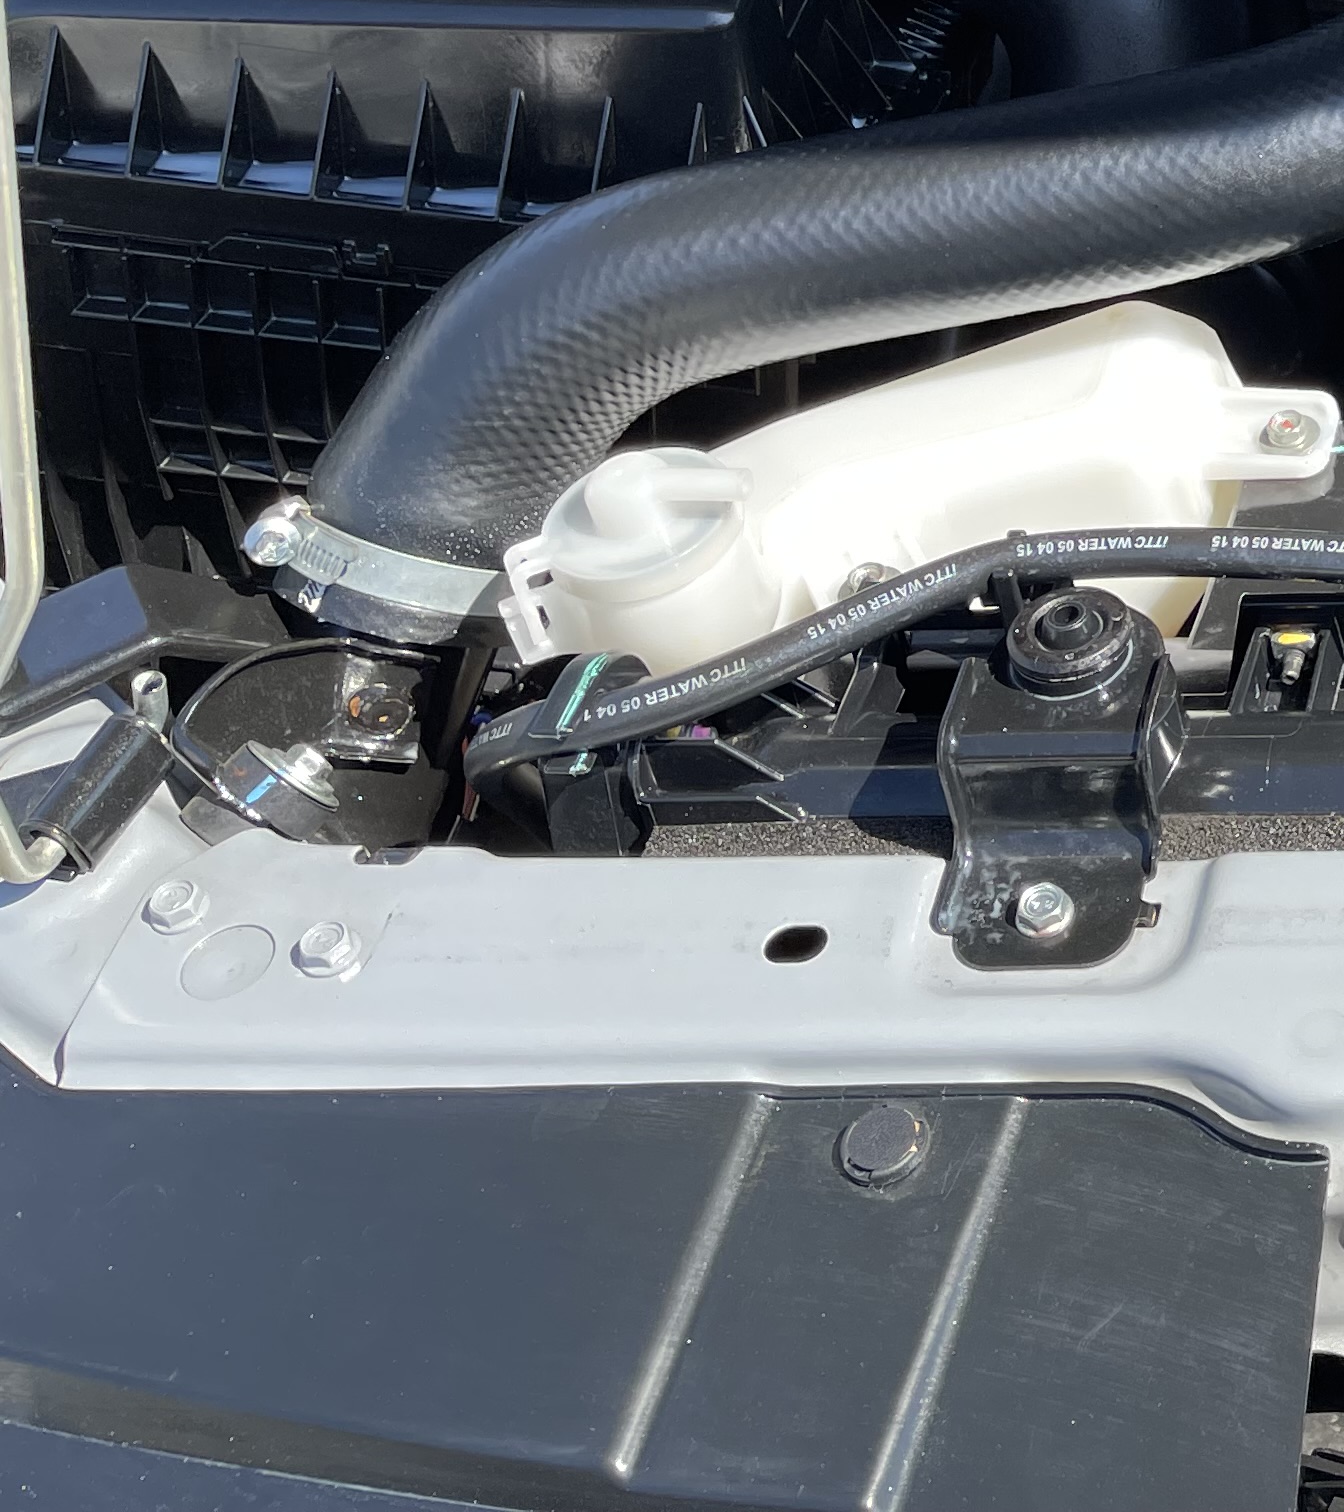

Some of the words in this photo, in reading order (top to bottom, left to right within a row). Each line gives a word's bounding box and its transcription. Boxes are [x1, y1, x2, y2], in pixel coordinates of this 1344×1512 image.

[1036, 541, 1054, 555] 04
[1058, 540, 1074, 553] 05
[1078, 537, 1132, 551] WATER
[1211, 535, 1228, 548] 15
[1232, 536, 1249, 549] 04
[1251, 536, 1269, 549] 05
[1271, 538, 1325, 552] WATER
[1016, 543, 1027, 557] 15
[867, 578, 924, 611] WATER
[848, 603, 867, 621] 05
[828, 613, 846, 630] 04
[807, 623, 825, 639] 15
[645, 677, 703, 705] WATER
[597, 704, 616, 719] 04
[621, 697, 641, 713] 05
